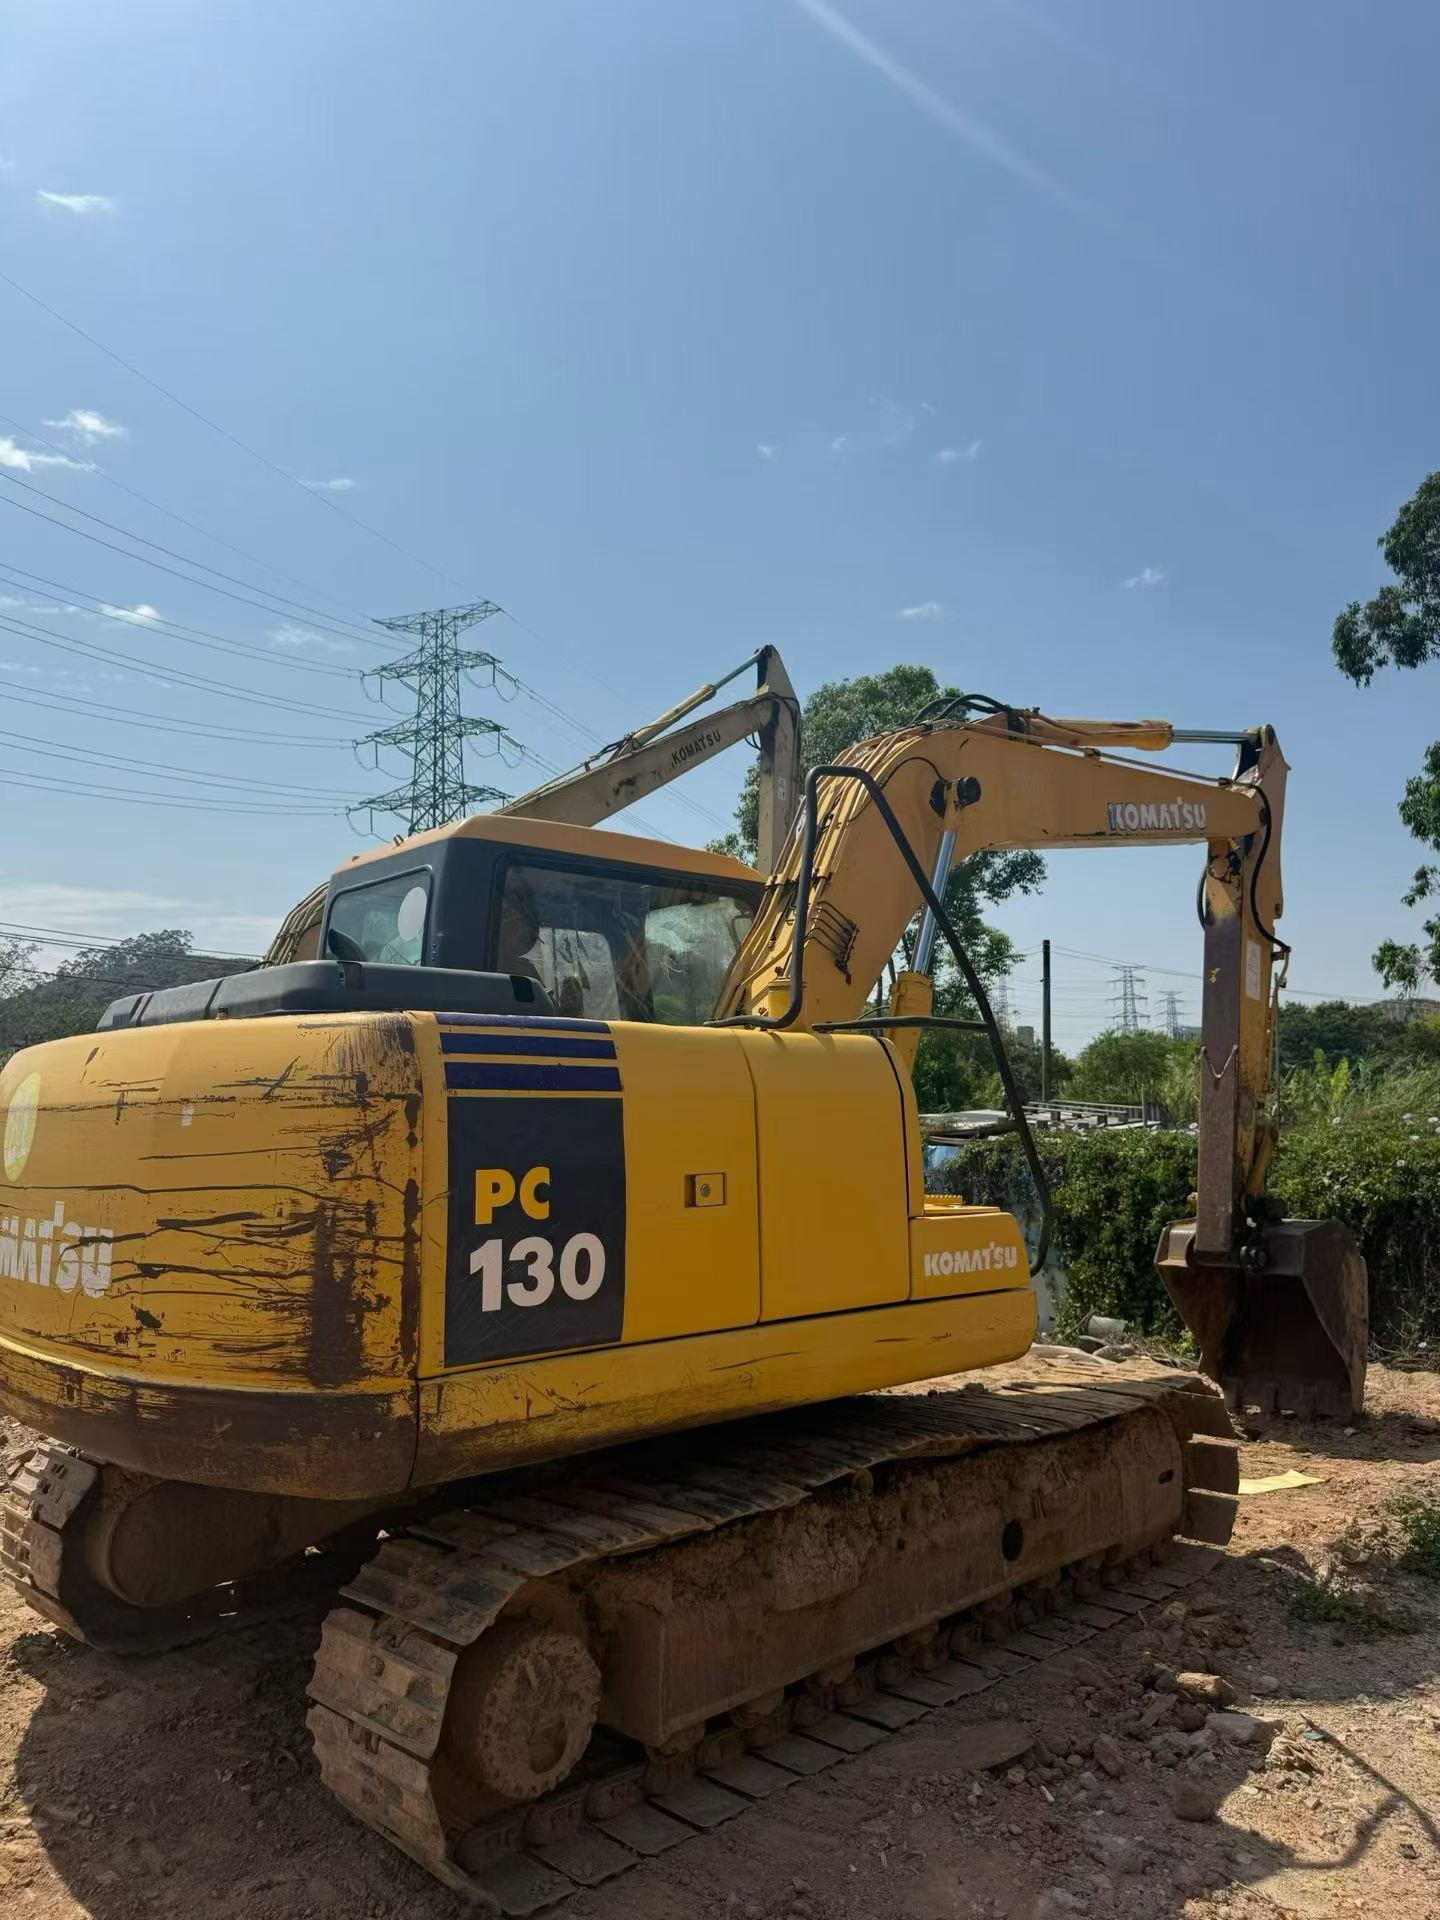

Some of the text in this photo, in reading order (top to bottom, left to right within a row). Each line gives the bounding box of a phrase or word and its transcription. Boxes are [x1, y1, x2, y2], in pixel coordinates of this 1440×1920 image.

[671, 729, 721, 767] KOMATSU
[1107, 796, 1207, 832] KOMATSU
[475, 1166, 550, 1225] PC
[469, 1232, 606, 1312] 130
[923, 1241, 1017, 1277] KOMATSU
